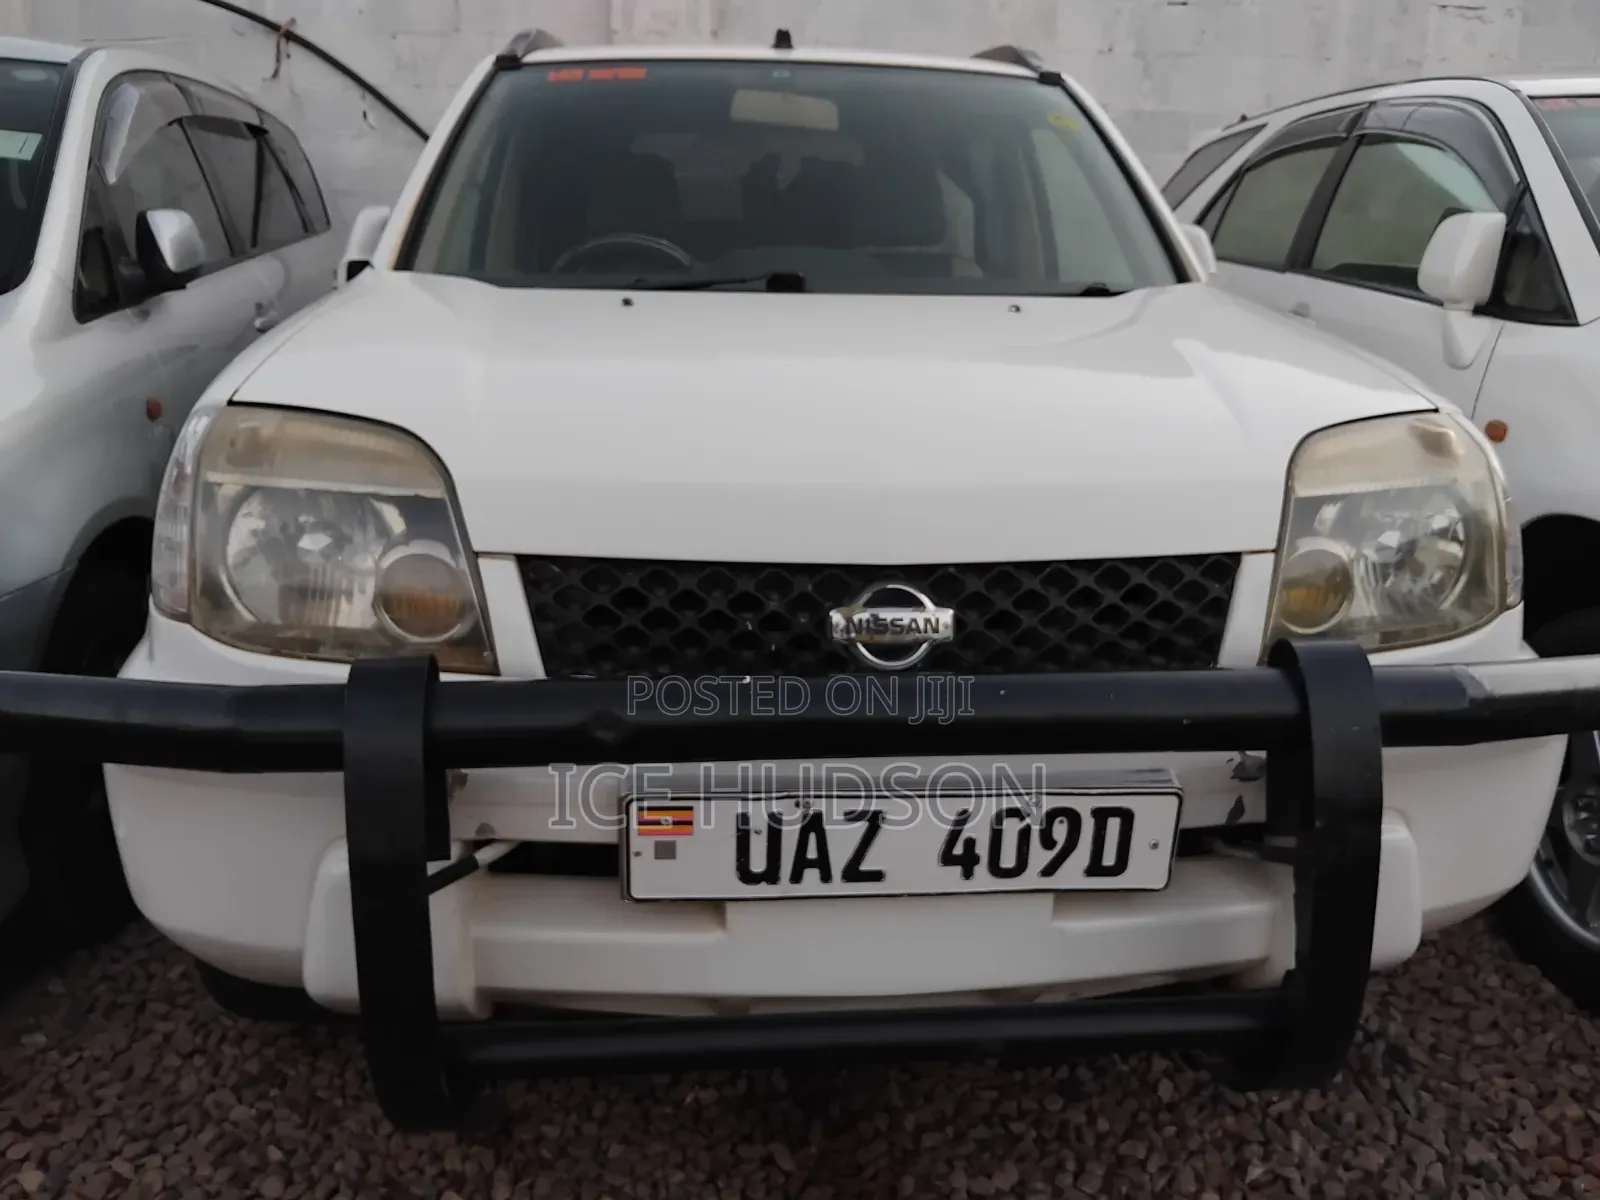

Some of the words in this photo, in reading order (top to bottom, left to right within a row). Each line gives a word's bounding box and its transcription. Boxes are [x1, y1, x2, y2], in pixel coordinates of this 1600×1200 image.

[844, 616, 940, 635] NISSAN
[735, 809, 888, 886] UAZ
[938, 806, 1136, 880] 409D
